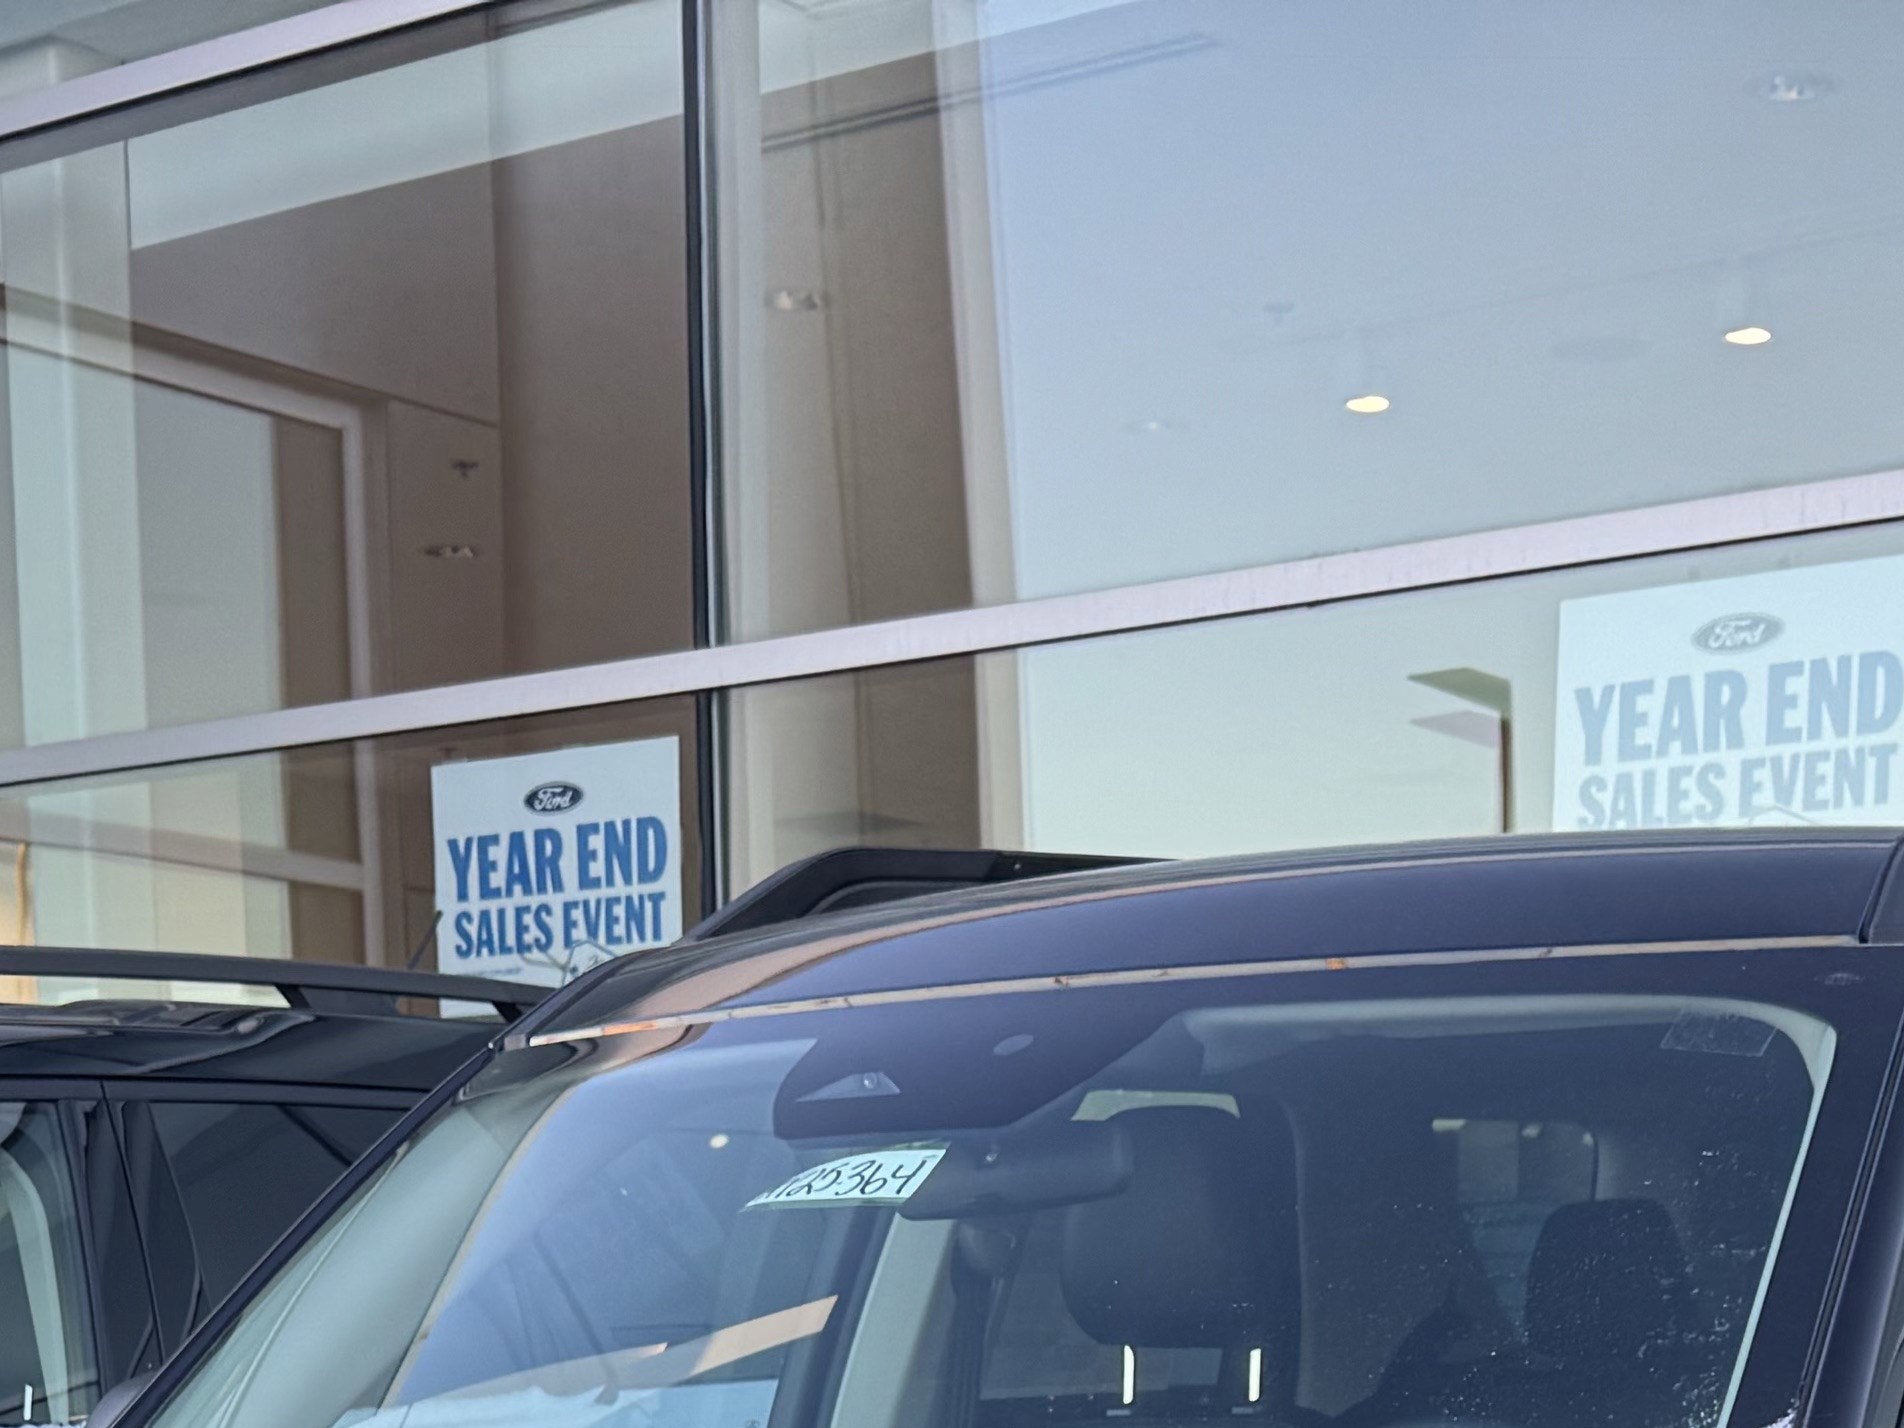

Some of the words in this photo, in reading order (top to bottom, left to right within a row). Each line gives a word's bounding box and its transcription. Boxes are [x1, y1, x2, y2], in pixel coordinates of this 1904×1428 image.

[1575, 670, 1747, 767] YEAR
[1765, 651, 1904, 747] END
[1578, 761, 1726, 829] SALES
[1738, 743, 1898, 818] EVENT
[447, 828, 563, 901] YEAR
[577, 816, 667, 891] END
[455, 903, 552, 959] SALES
[564, 891, 666, 951] EVENT
